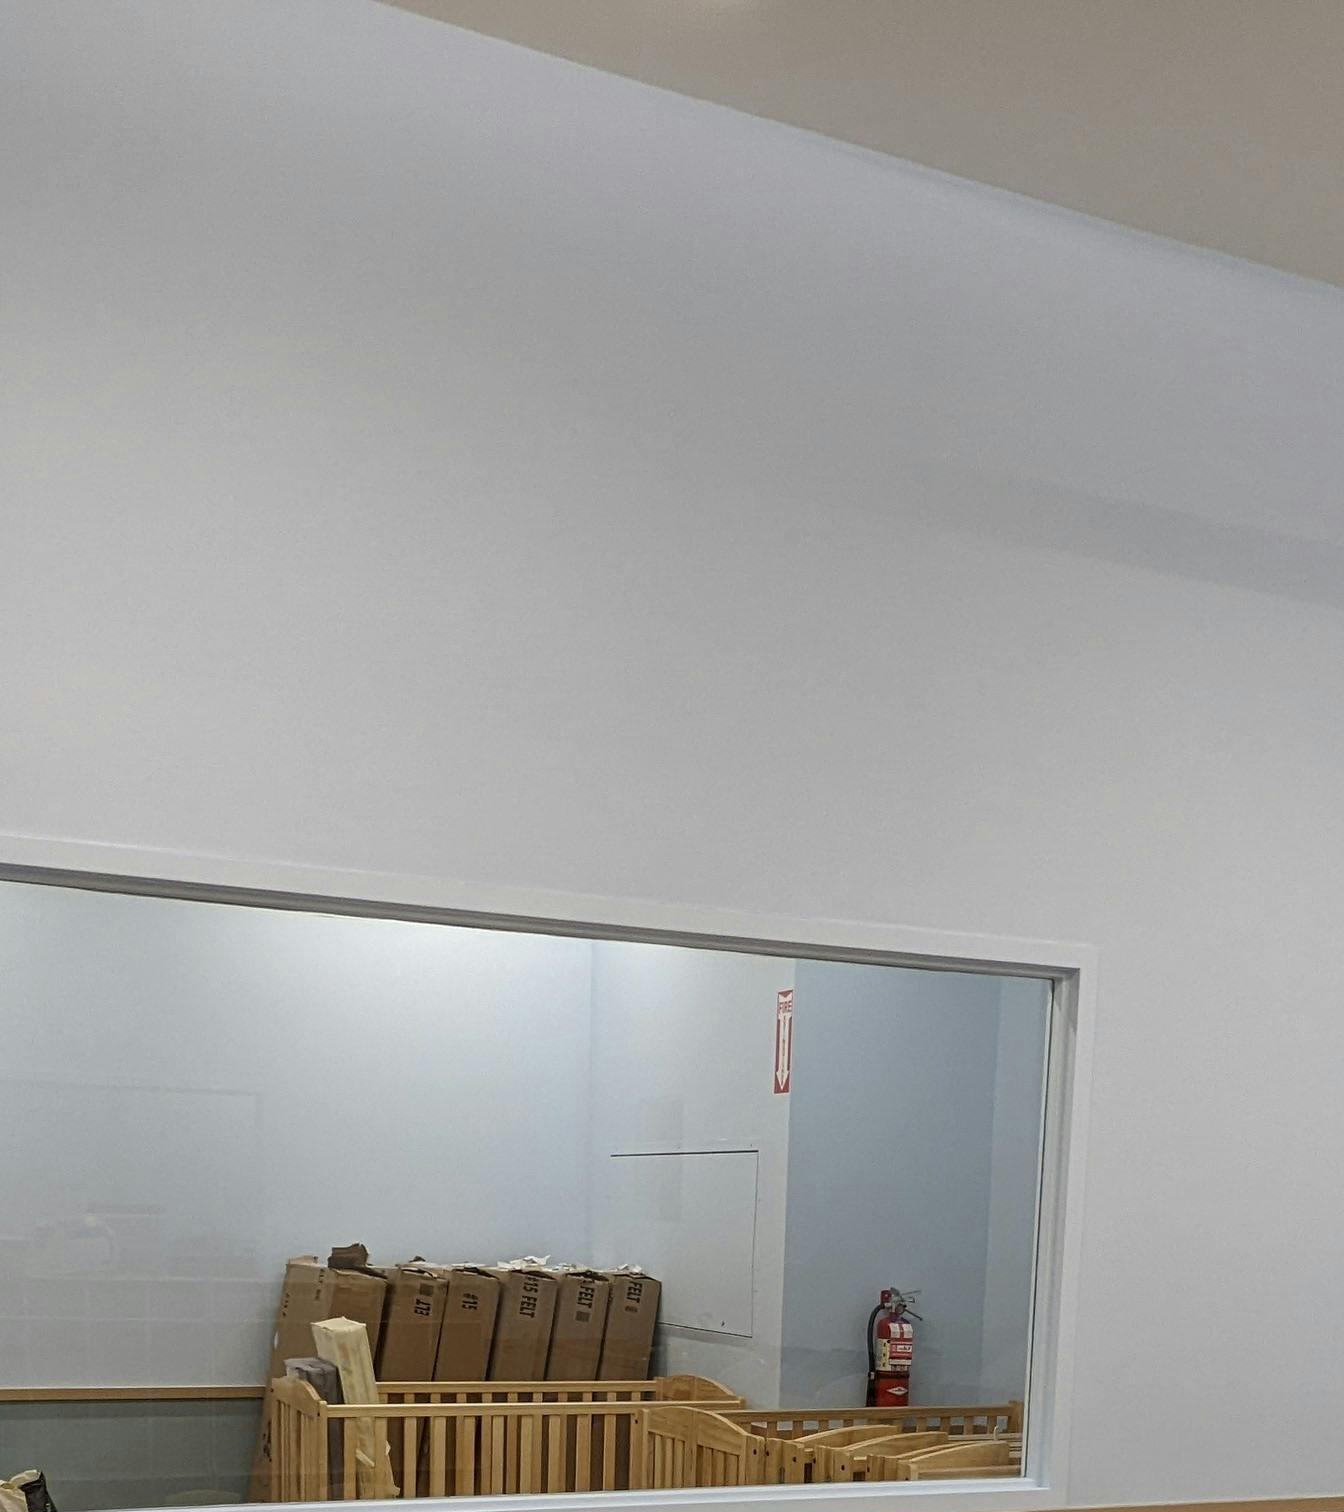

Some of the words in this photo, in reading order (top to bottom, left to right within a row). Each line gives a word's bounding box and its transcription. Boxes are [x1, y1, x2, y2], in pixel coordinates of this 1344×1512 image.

[779, 1000, 793, 1012] FIRE
[576, 1285, 595, 1309] FELT
[626, 1281, 643, 1303] FELT
[520, 1295, 538, 1318] FELT
